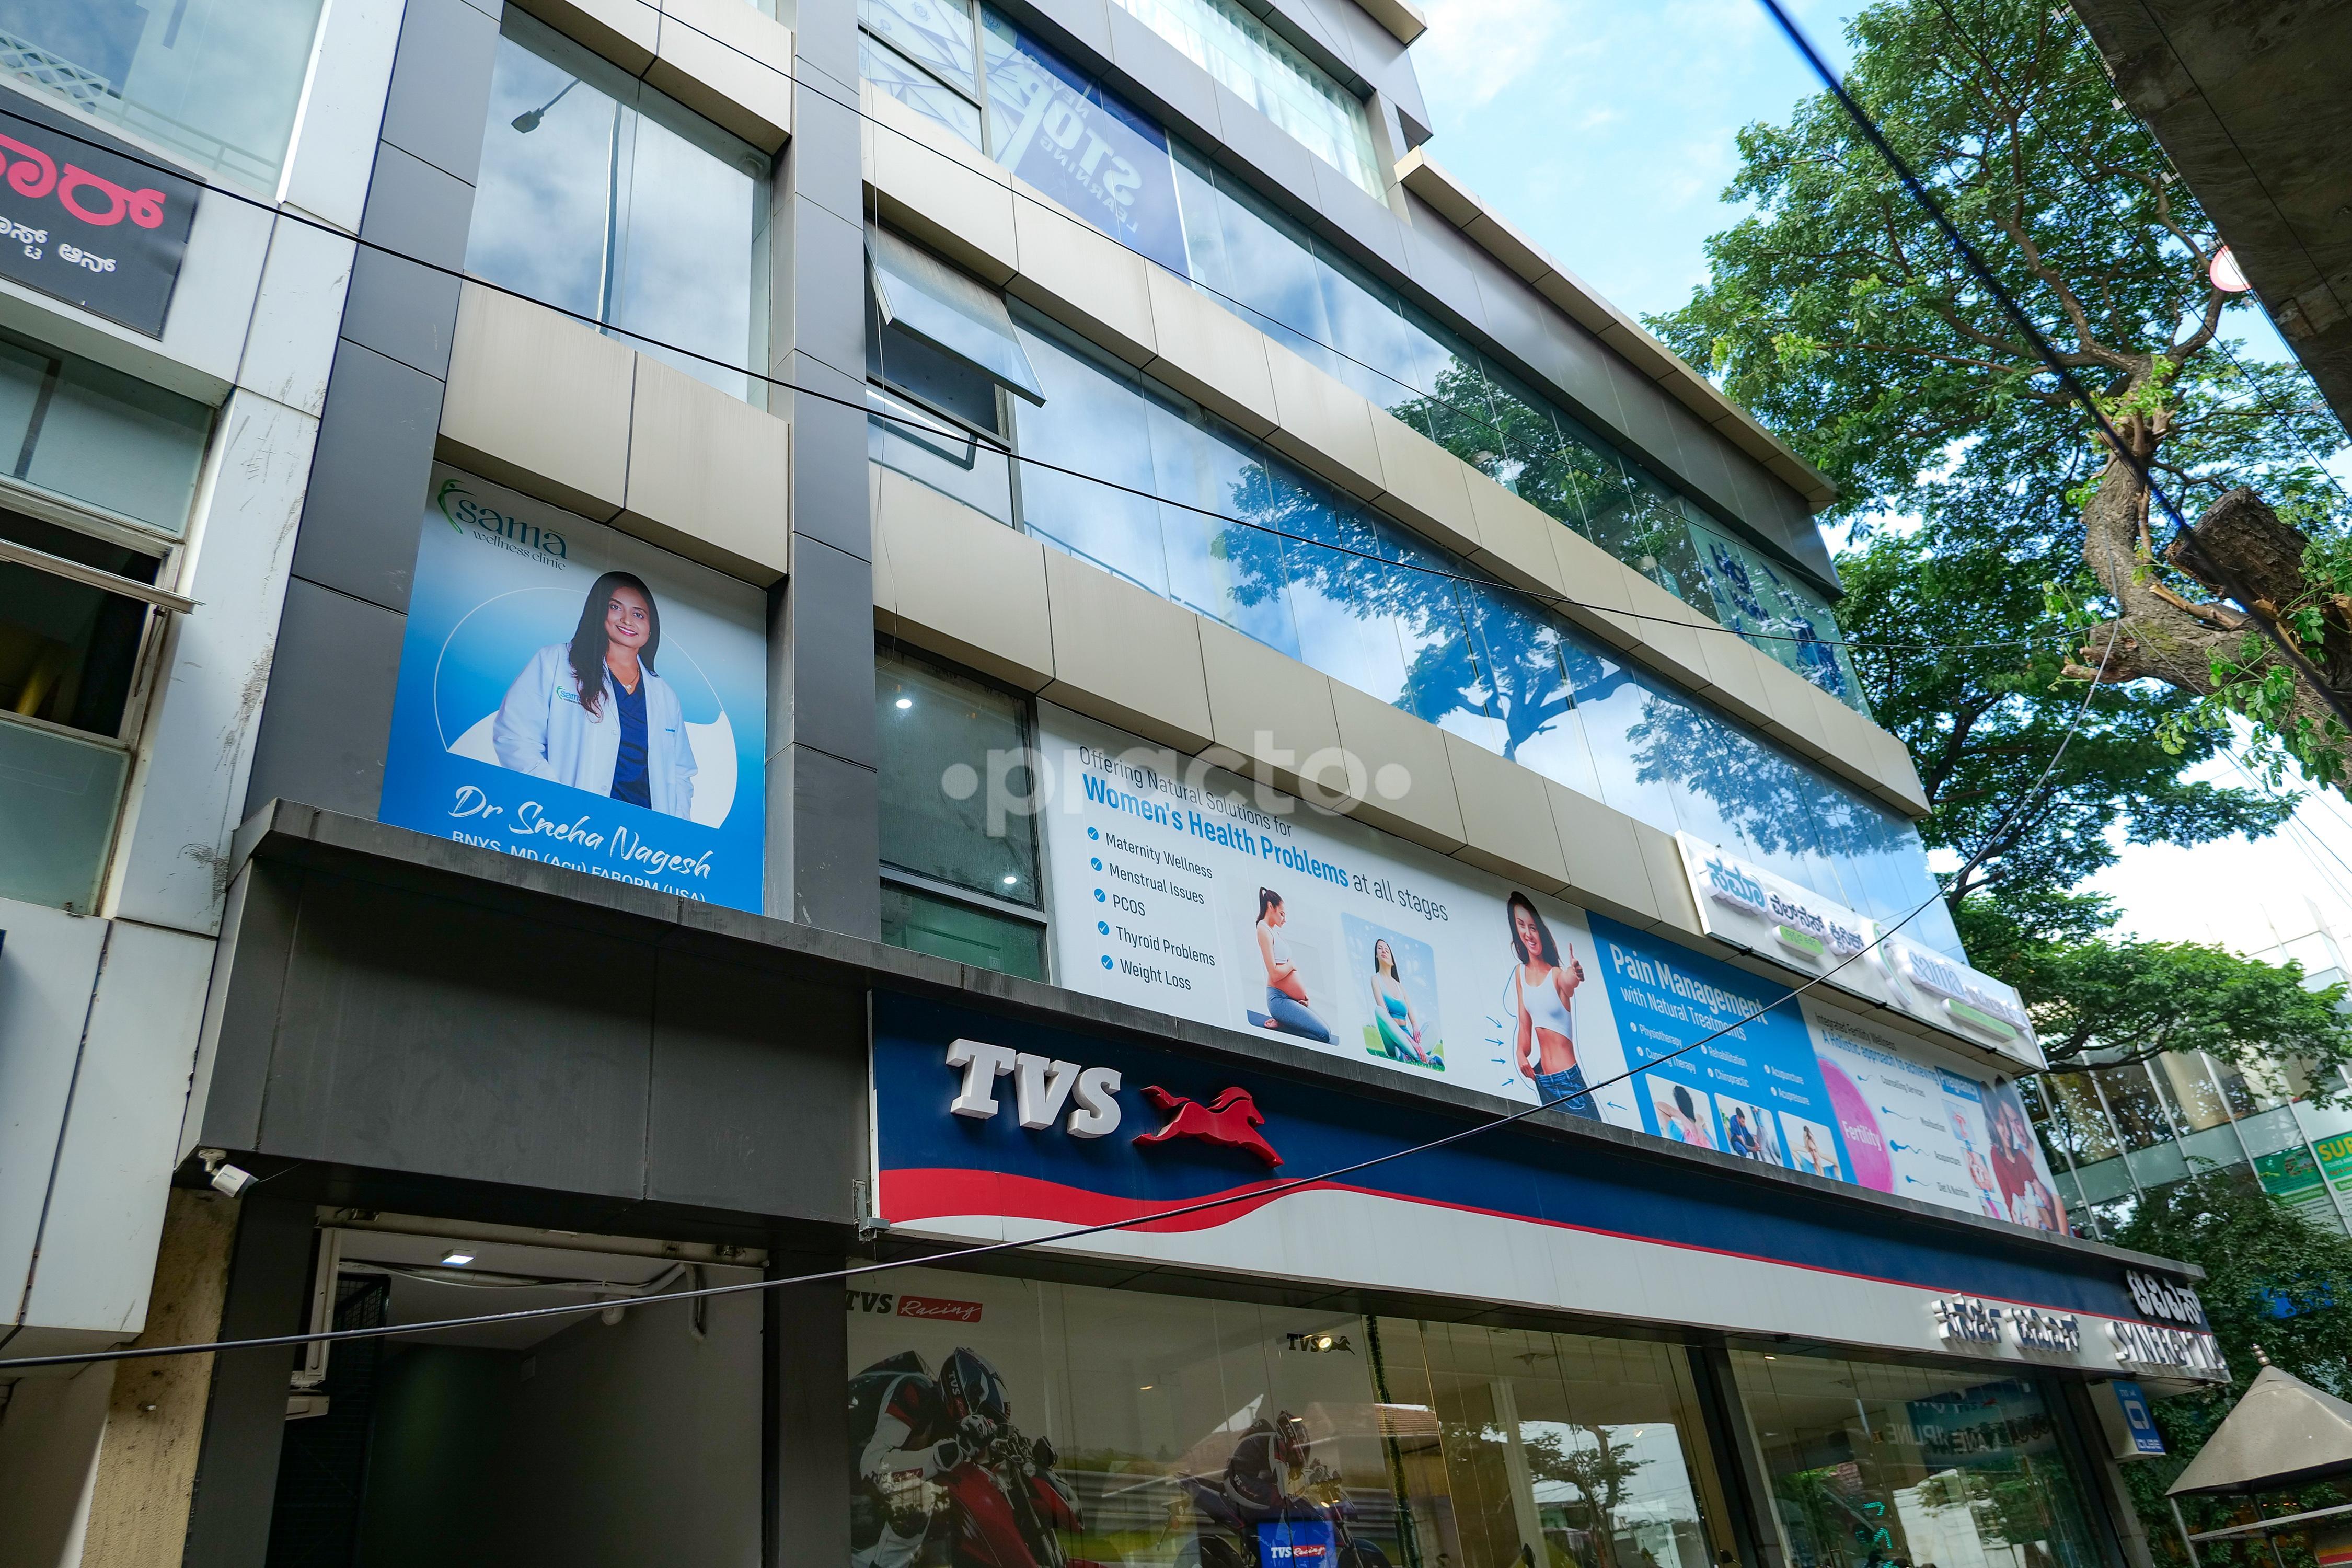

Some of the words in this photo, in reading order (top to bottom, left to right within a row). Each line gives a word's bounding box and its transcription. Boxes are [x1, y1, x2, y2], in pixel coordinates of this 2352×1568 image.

[472, 530, 530, 558] wellness
[532, 552, 566, 571] clinic
[1079, 746, 1144, 789] Offering
[1147, 769, 1203, 806] Natural
[1206, 792, 1271, 830] Solutions
[1274, 816, 1292, 837] for
[448, 785, 503, 819] Dr
[508, 801, 604, 850] Sneha
[609, 825, 714, 879] Nagesh
[1082, 773, 1183, 831] Women's
[1188, 810, 1256, 856] Health
[1260, 835, 1348, 887] Problems
[1353, 874, 1370, 895] at
[1374, 878, 1395, 903] all
[1398, 889, 1448, 921] stages
[510, 845, 538, 861] MD
[1105, 832, 1161, 865] Maternity
[1163, 850, 1213, 879] Wellness
[1109, 862, 1167, 893] Menstrual
[1170, 881, 1204, 905] Issues
[1113, 894, 1146, 916] PCOS
[1116, 926, 1160, 951] Thyroid
[1163, 939, 1215, 966] Problems
[1120, 958, 1162, 984] Weight
[1165, 970, 1191, 990] Loss
[1609, 943, 1656, 986] Pain
[1654, 960, 1768, 1025] Management
[1620, 986, 1647, 1008] with
[1647, 992, 1689, 1022] Natural
[1687, 1006, 1747, 1041] Treatments
[1639, 1023, 1682, 1048] Physiotherapy
[1821, 1029, 1830, 1045] A
[1672, 1056, 1697, 1074] Therapy
[946, 1037, 1122, 1138] TVS
[1841, 1120, 1882, 1151] Fertility
[846, 1289, 893, 1314] TVS
[900, 1299, 981, 1320] Racing
[1287, 1333, 1320, 1353] TVS
[948, 1370, 961, 1396] TVS
[1271, 1546, 1293, 1559] TVS
